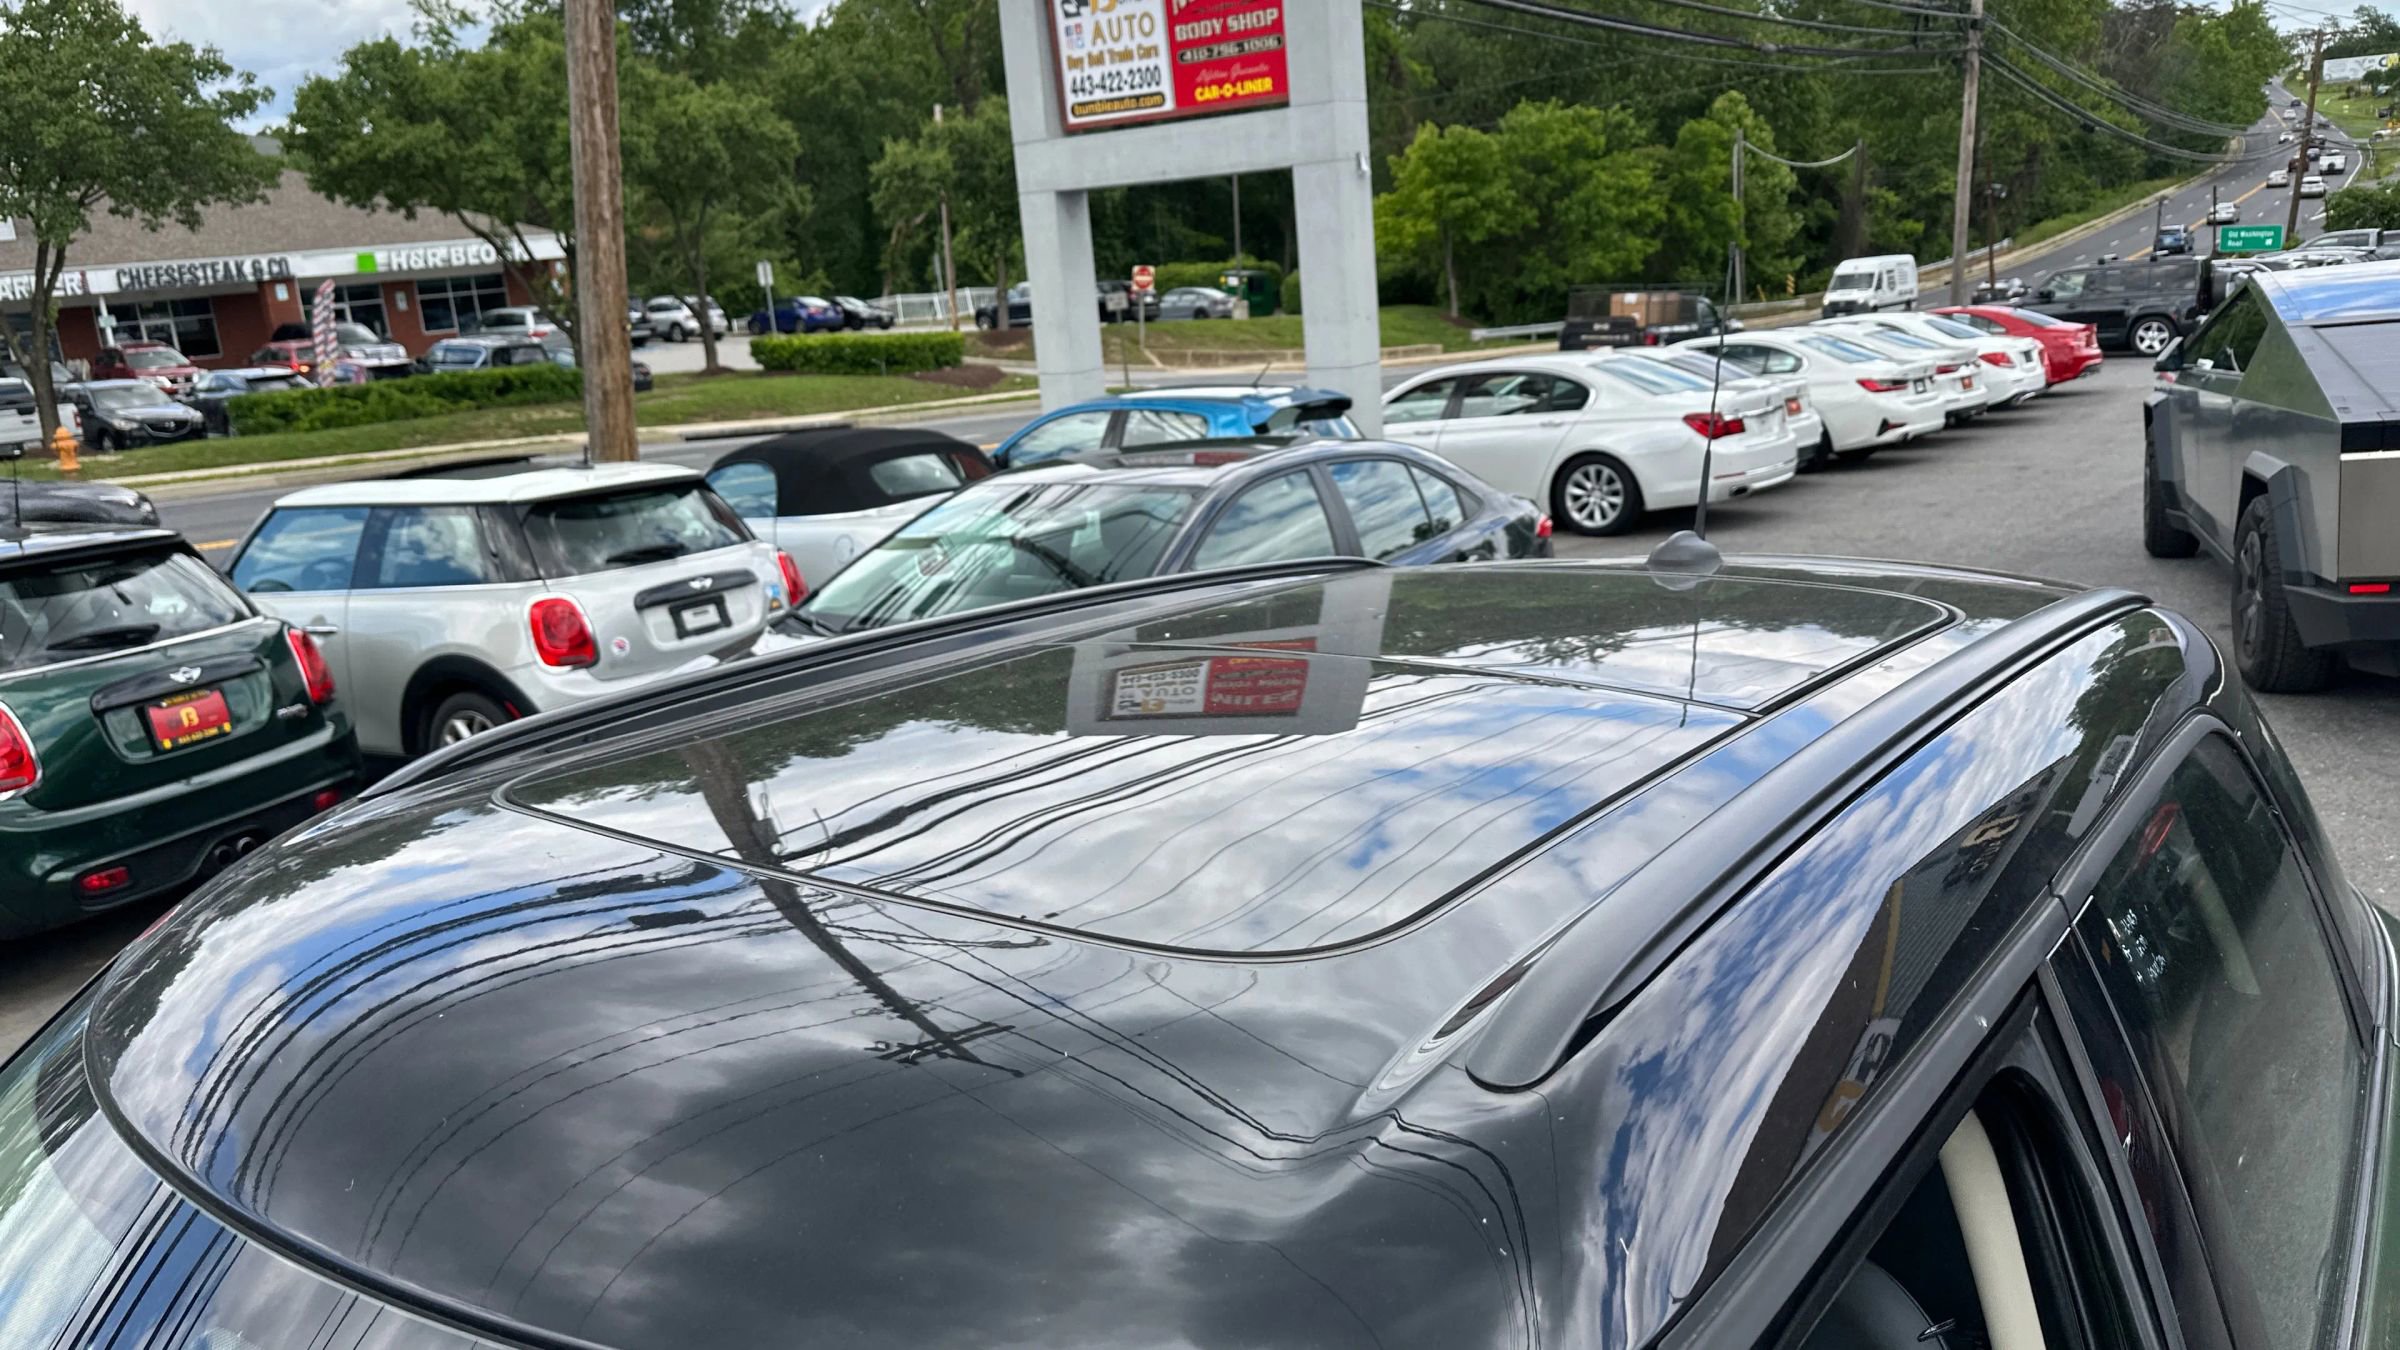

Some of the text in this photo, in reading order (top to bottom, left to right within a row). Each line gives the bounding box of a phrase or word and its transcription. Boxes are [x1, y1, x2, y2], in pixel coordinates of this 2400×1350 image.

[1092, 12, 1155, 46] AUTO
[1174, 8, 1279, 41] BODY SHOP
[1071, 64, 1162, 97] 443-422-2300
[1194, 77, 1274, 103] CAR-O-LINER
[116, 259, 247, 292] CHEESESTEAK
[251, 257, 264, 280] &
[390, 246, 446, 272] H&R
